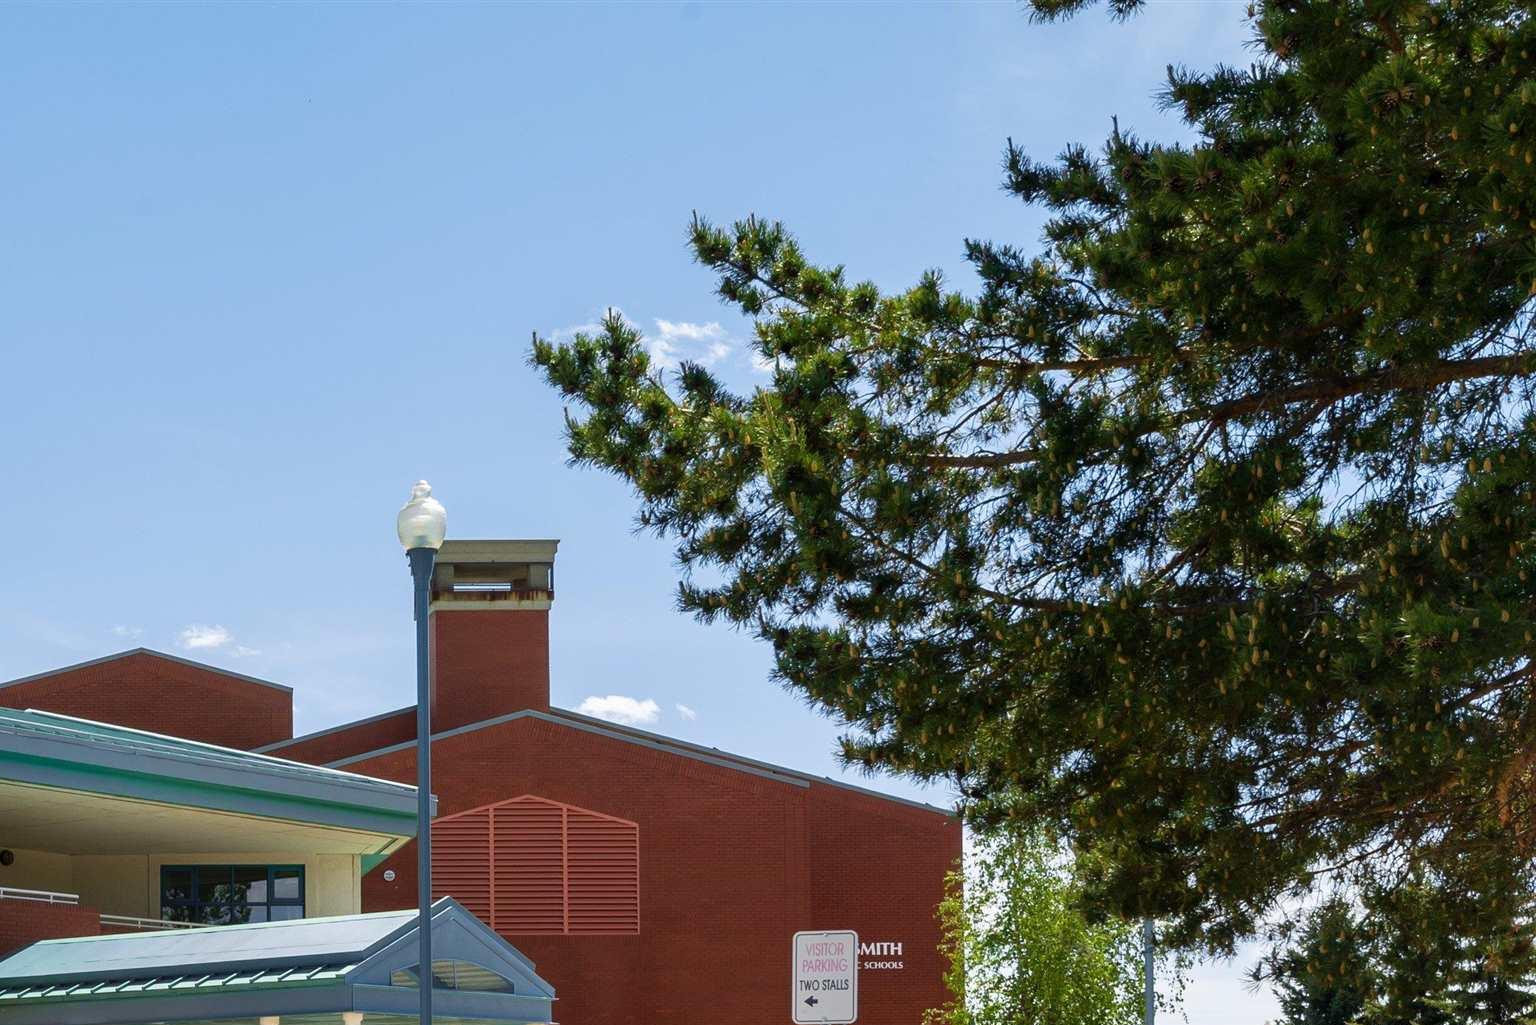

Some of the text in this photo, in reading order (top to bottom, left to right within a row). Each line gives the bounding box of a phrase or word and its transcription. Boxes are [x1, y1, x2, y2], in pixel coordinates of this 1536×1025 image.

[805, 942, 845, 956] VISITOR
[802, 958, 848, 972] PARKING
[864, 961, 904, 969] SCHOOLS
[799, 979, 849, 991] TWO STALLS
